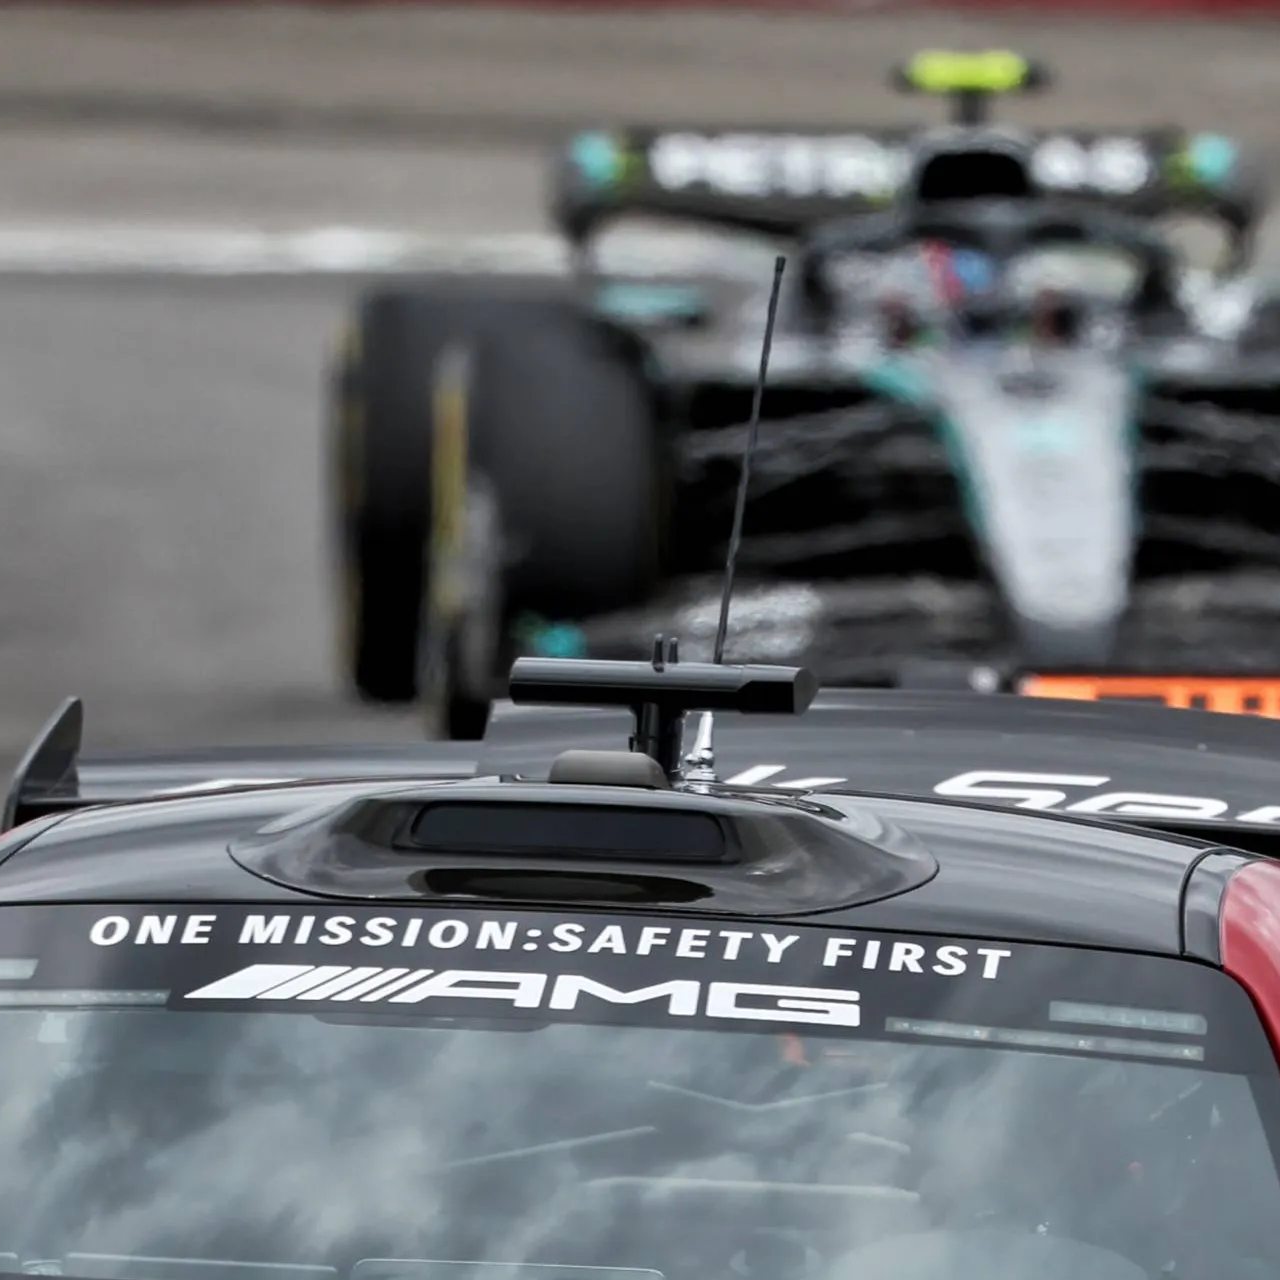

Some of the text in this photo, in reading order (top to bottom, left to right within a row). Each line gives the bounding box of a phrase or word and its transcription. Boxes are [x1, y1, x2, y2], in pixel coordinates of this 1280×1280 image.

[89, 914, 1011, 979] ONE MISSION:SAFETY FIRST
[387, 969, 861, 1028] AMG
